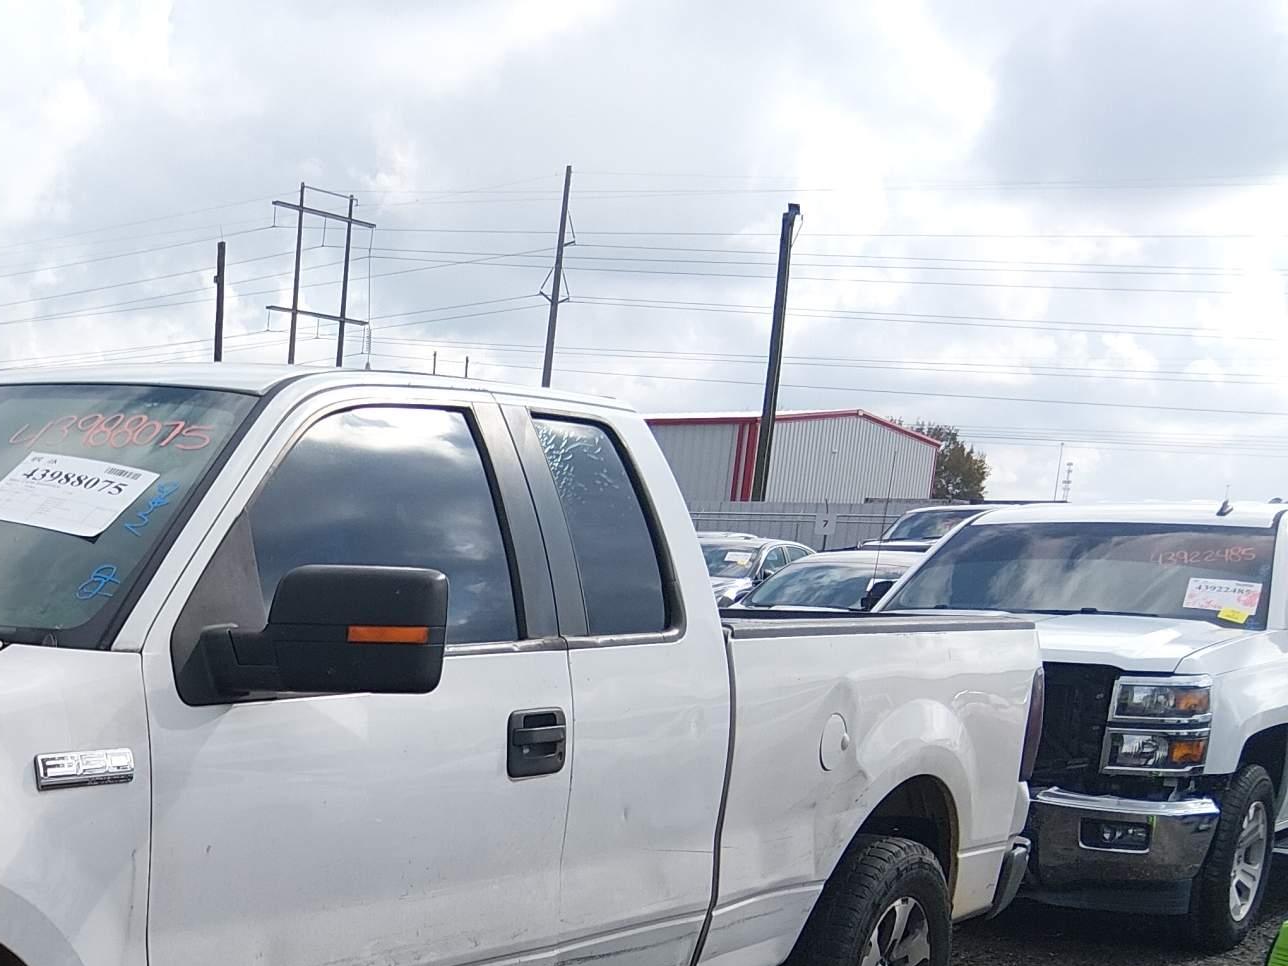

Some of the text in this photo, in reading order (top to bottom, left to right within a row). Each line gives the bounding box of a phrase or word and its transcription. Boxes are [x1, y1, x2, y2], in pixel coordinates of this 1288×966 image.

[9, 412, 215, 450] 43988075
[23, 467, 129, 497] 43988075
[1150, 547, 1257, 566] 43922485
